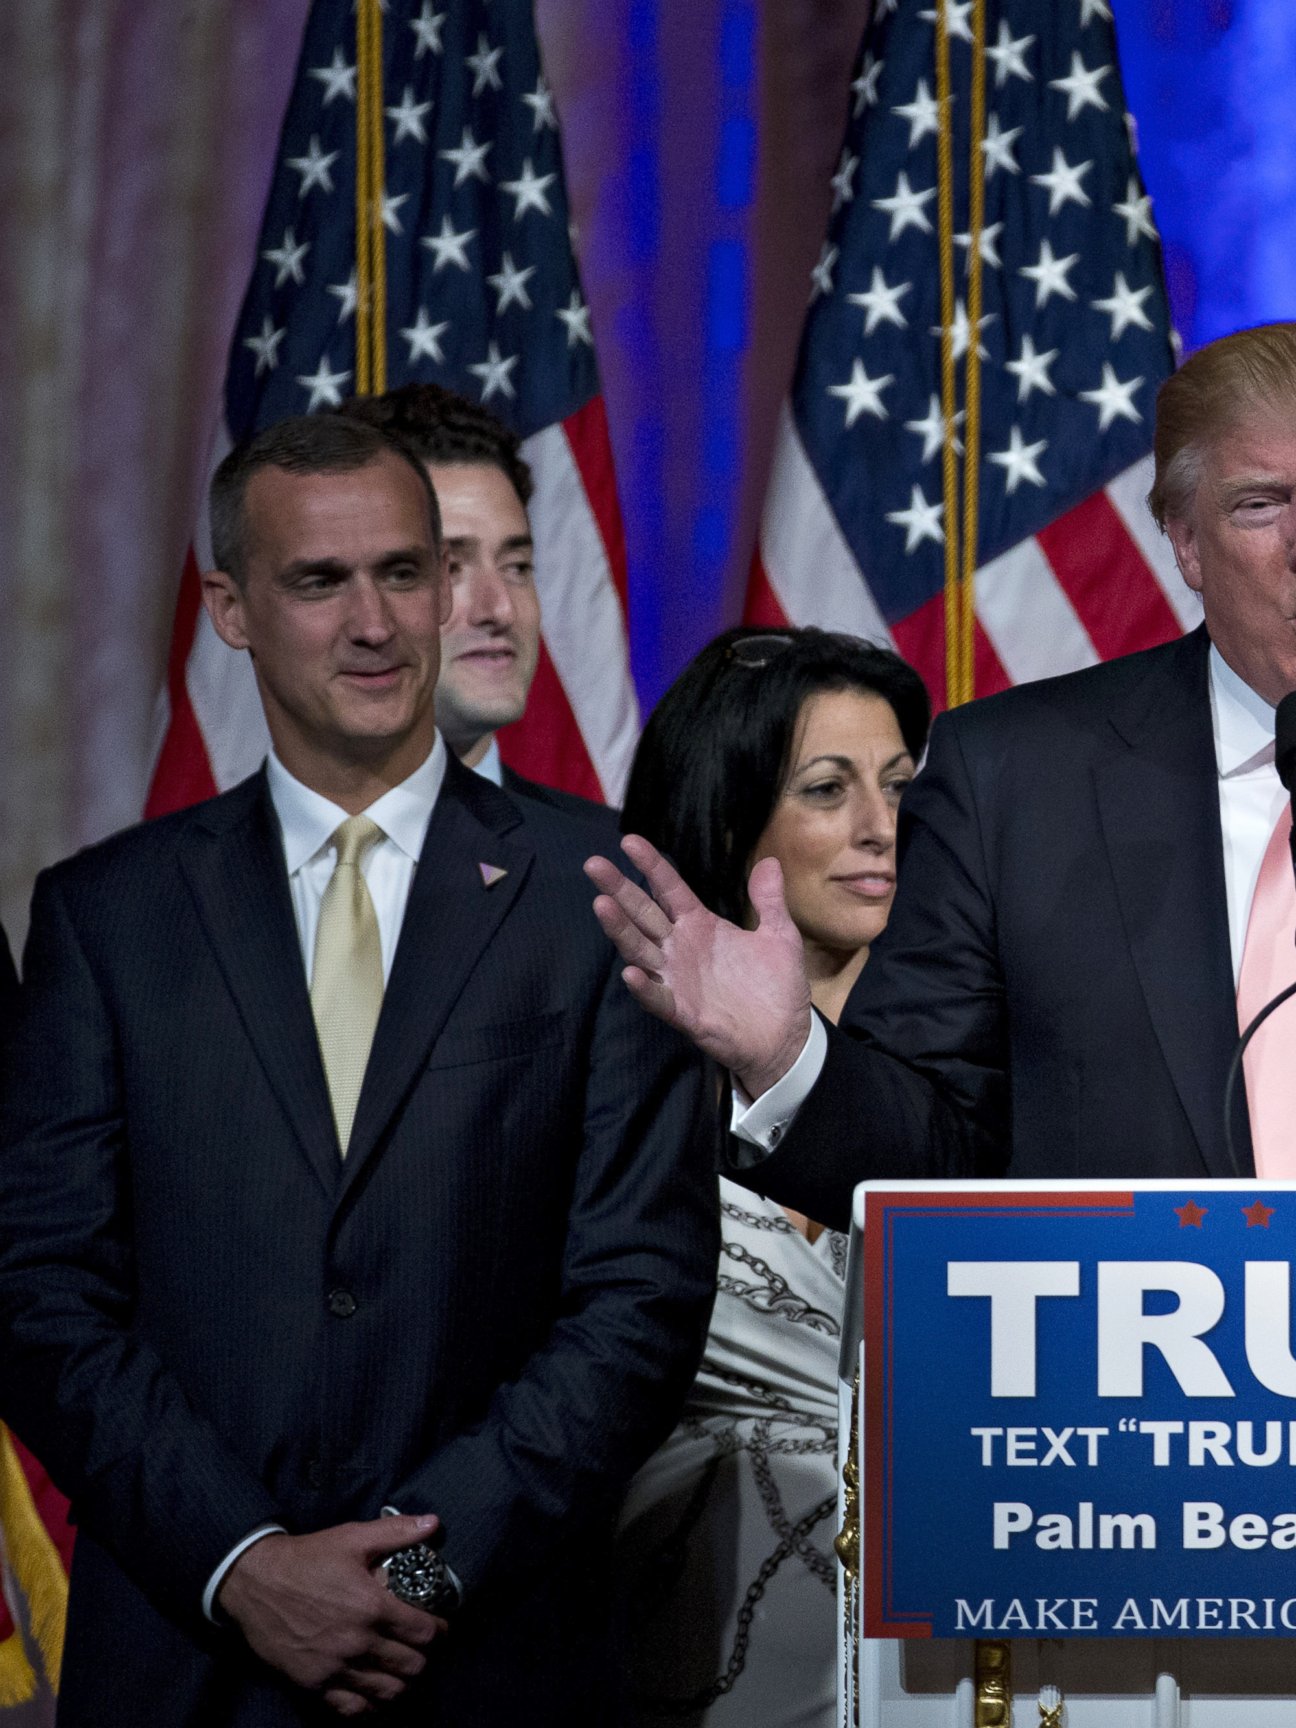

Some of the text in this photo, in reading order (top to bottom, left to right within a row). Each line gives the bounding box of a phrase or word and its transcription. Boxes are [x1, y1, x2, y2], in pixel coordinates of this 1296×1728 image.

[971, 1427, 1109, 1466] TEXT
[993, 1502, 1156, 1550] Palm
[955, 1598, 1098, 1630] MAKE
